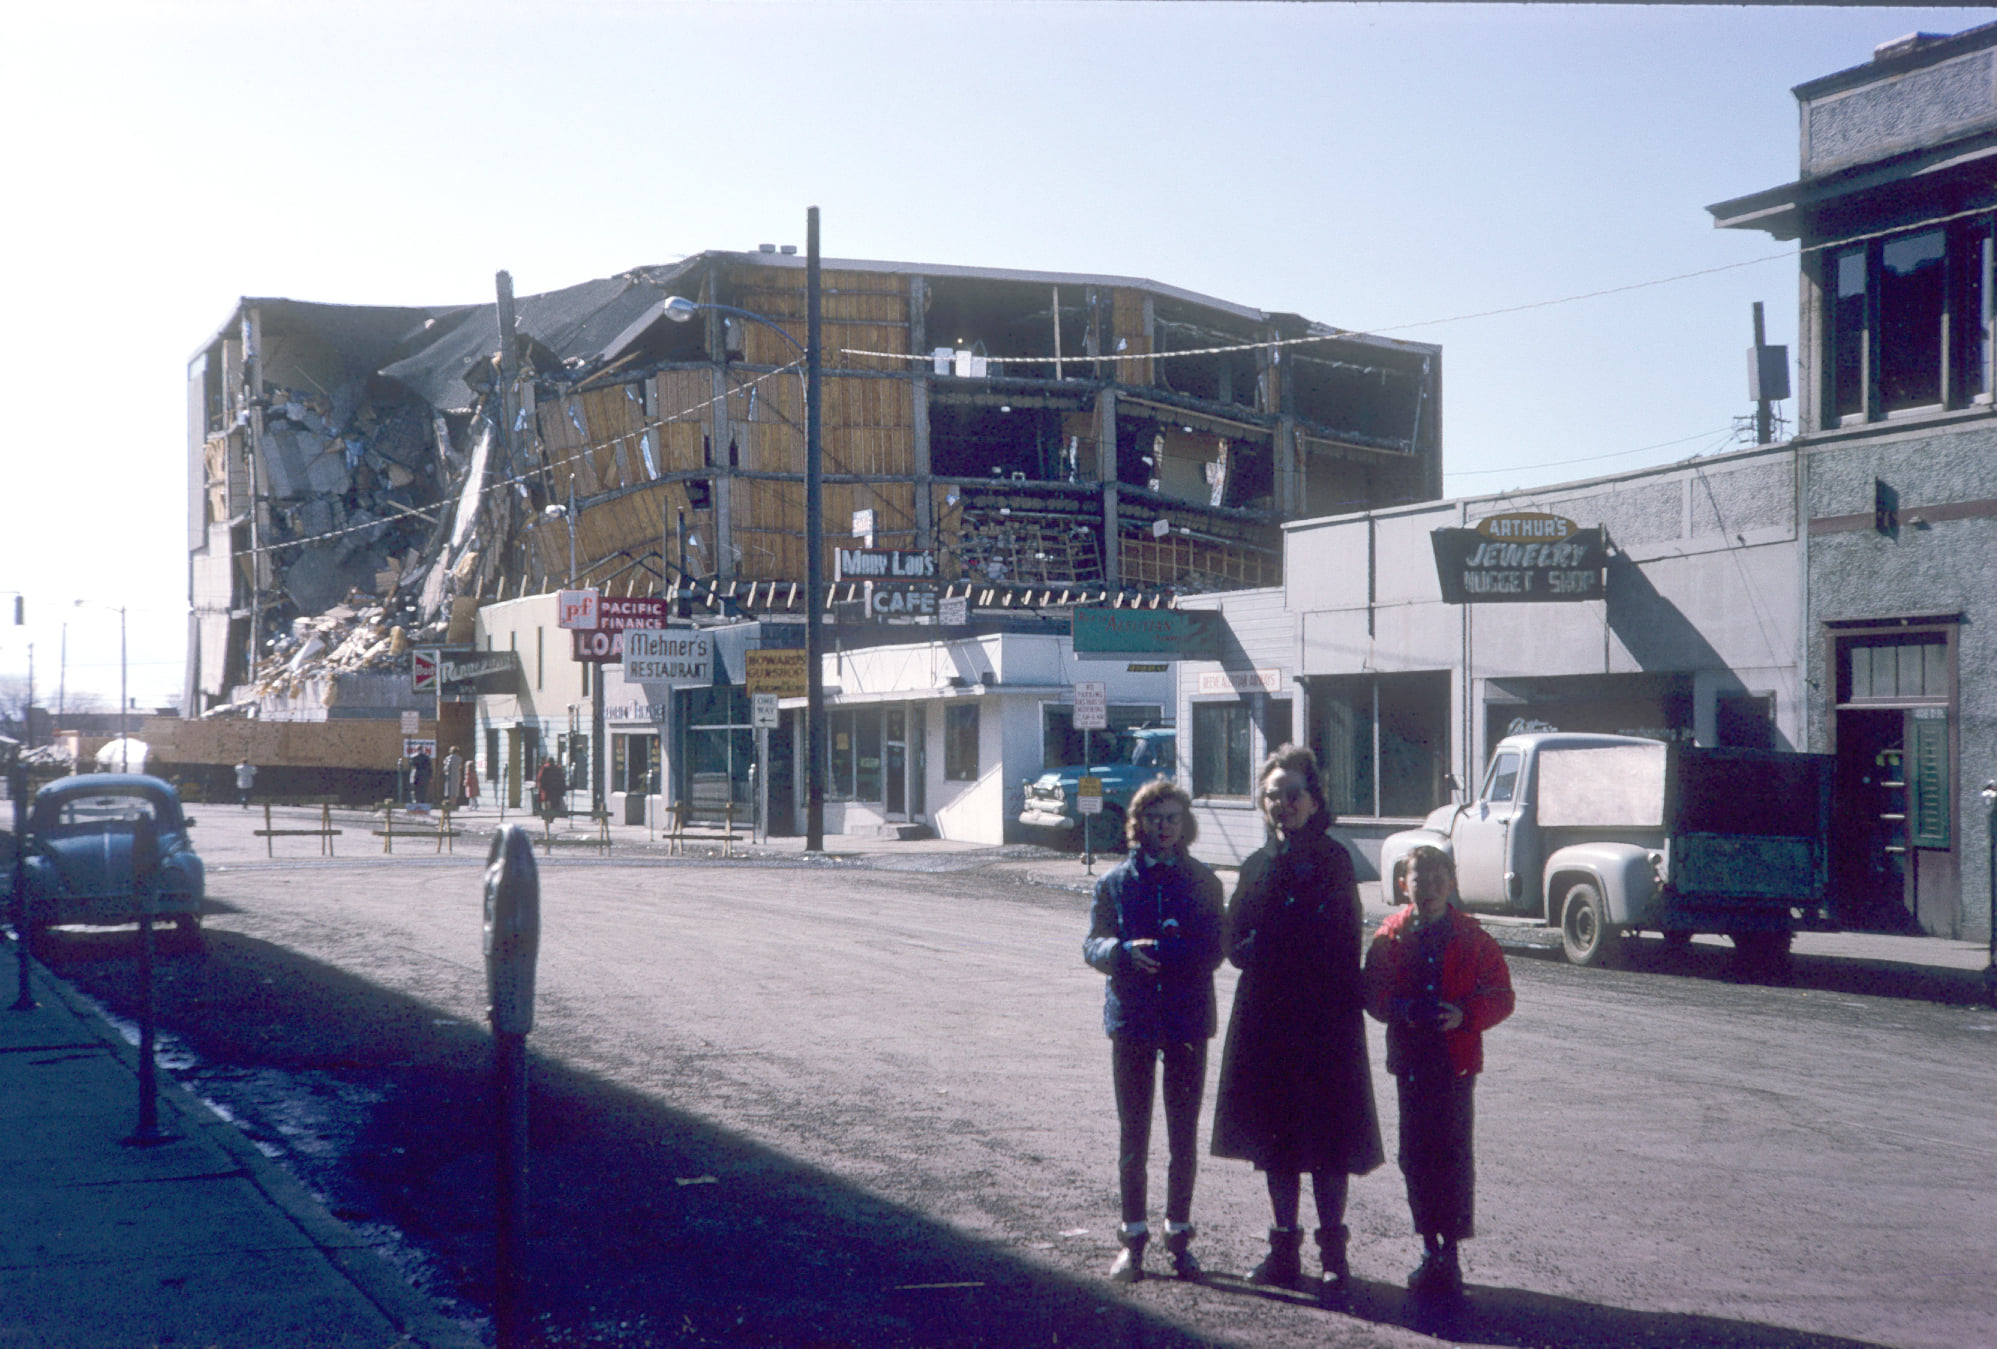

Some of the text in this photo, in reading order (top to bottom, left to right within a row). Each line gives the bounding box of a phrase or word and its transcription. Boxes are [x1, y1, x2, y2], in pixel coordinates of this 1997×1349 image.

[1489, 517, 1568, 537] ARTHUR'S
[1465, 542, 1589, 567] JEWELRY
[1464, 570, 1596, 593] NUGGET SHOP
[565, 597, 593, 623] pf
[601, 602, 662, 615] PACIFIC
[873, 591, 936, 613] CAFE
[601, 617, 662, 629] FINANCE
[579, 632, 624, 656] LOA
[631, 633, 707, 656] Mehner's
[631, 661, 707, 678] RESTAURANT
[757, 697, 773, 705] ONE
[757, 707, 774, 715] WAY
